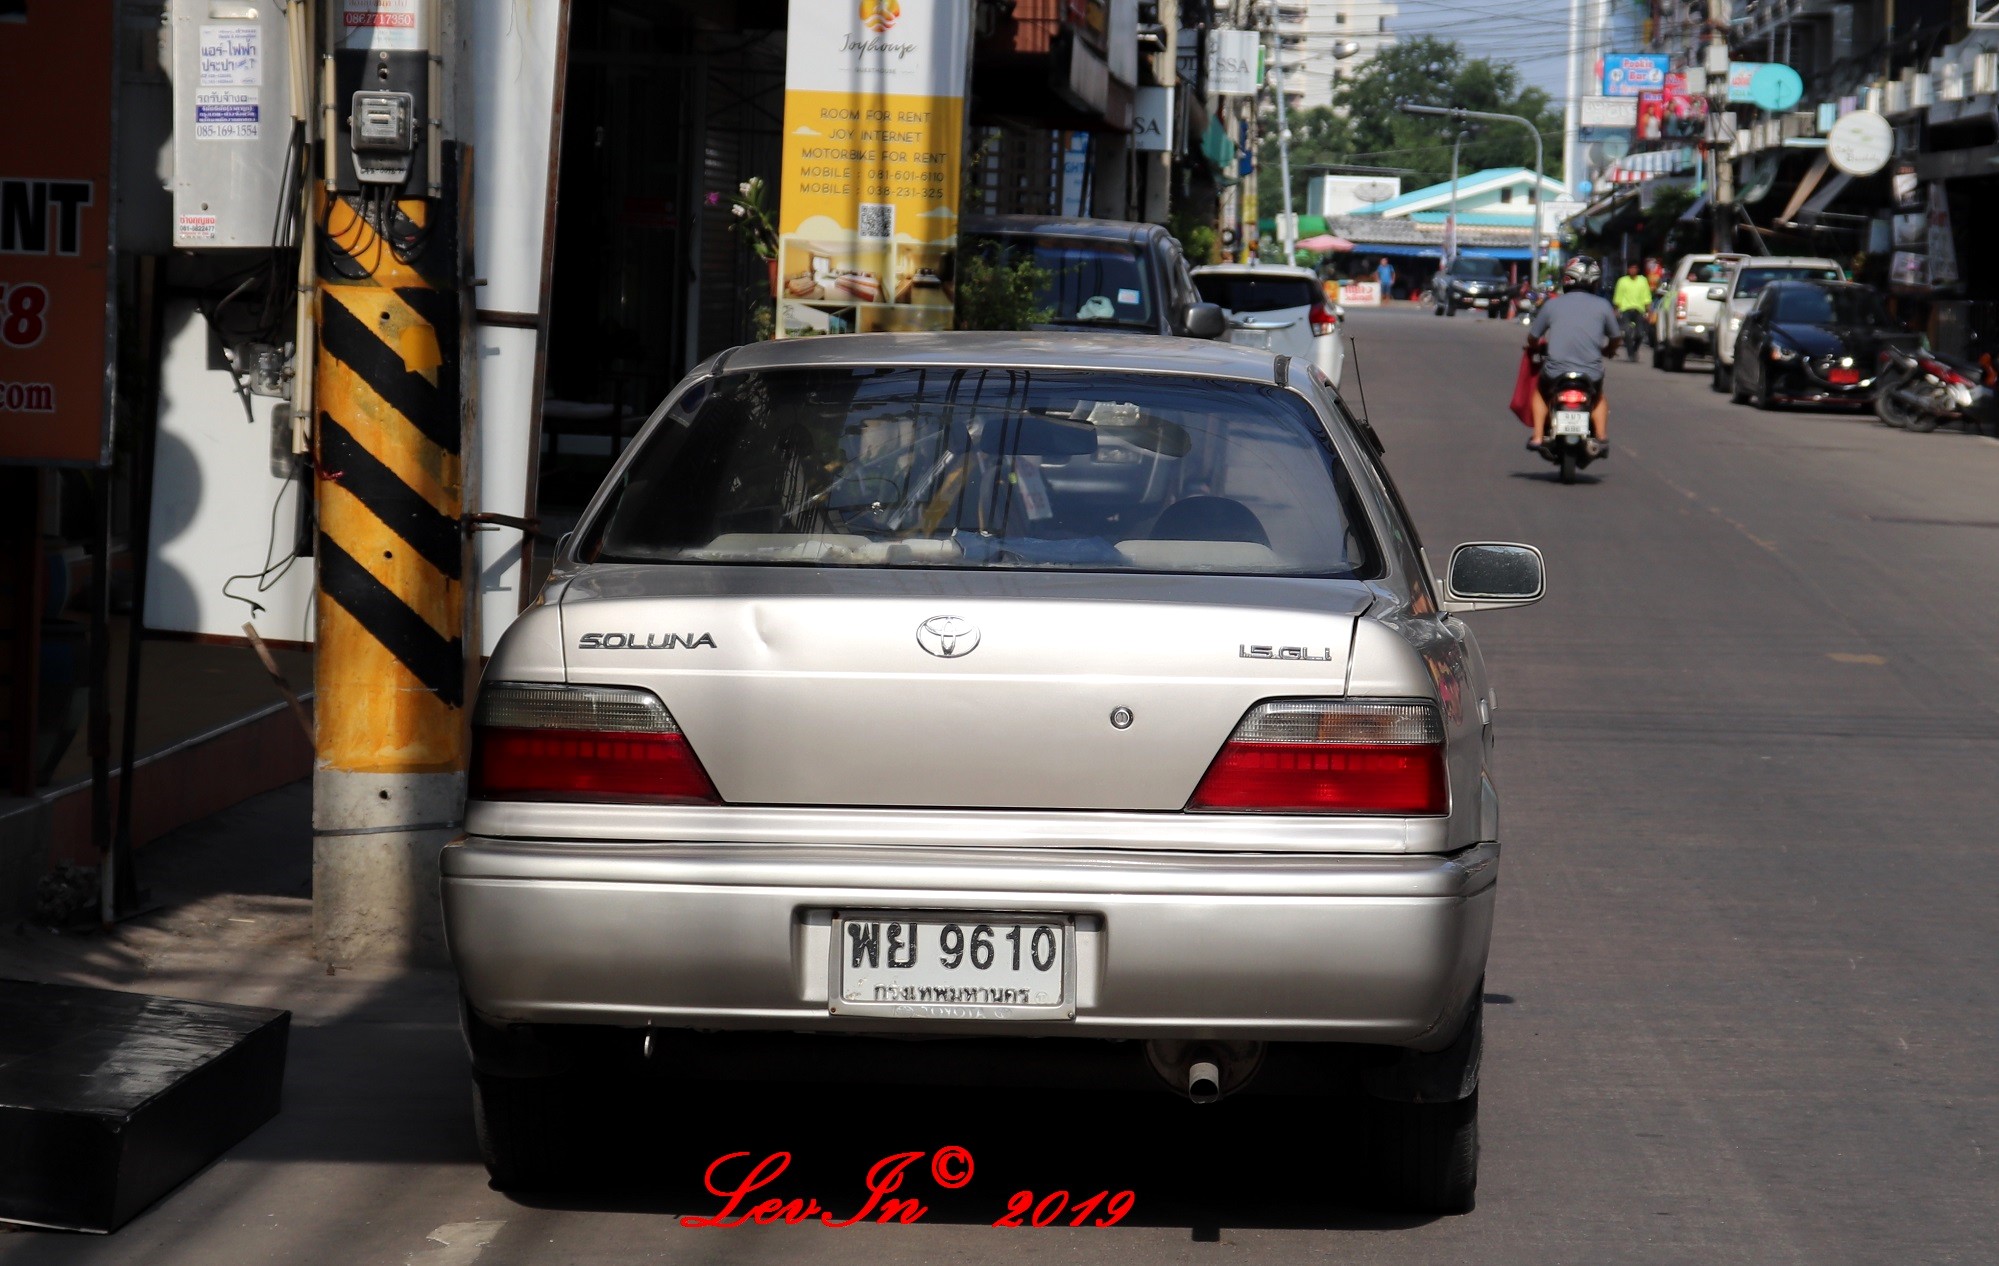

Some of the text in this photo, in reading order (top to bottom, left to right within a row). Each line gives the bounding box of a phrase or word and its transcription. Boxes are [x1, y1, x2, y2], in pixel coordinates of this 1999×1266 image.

[820, 107, 932, 123] ROOM FOR RENT
[197, 125, 258, 137] 085-169-1554
[828, 128, 923, 143] JOY INTERNET
[801, 147, 947, 164] MOTORBIKE FOR RENT
[800, 166, 851, 178] MOBILE
[867, 168, 945, 182] 081-601-6110
[800, 183, 851, 194] MOBILE
[0, 285, 46, 345] 8
[579, 632, 717, 649] SOLUNA
[848, 921, 1056, 971] พย 9610
[874, 984, 1031, 1003] กรงเทพมหานคร
